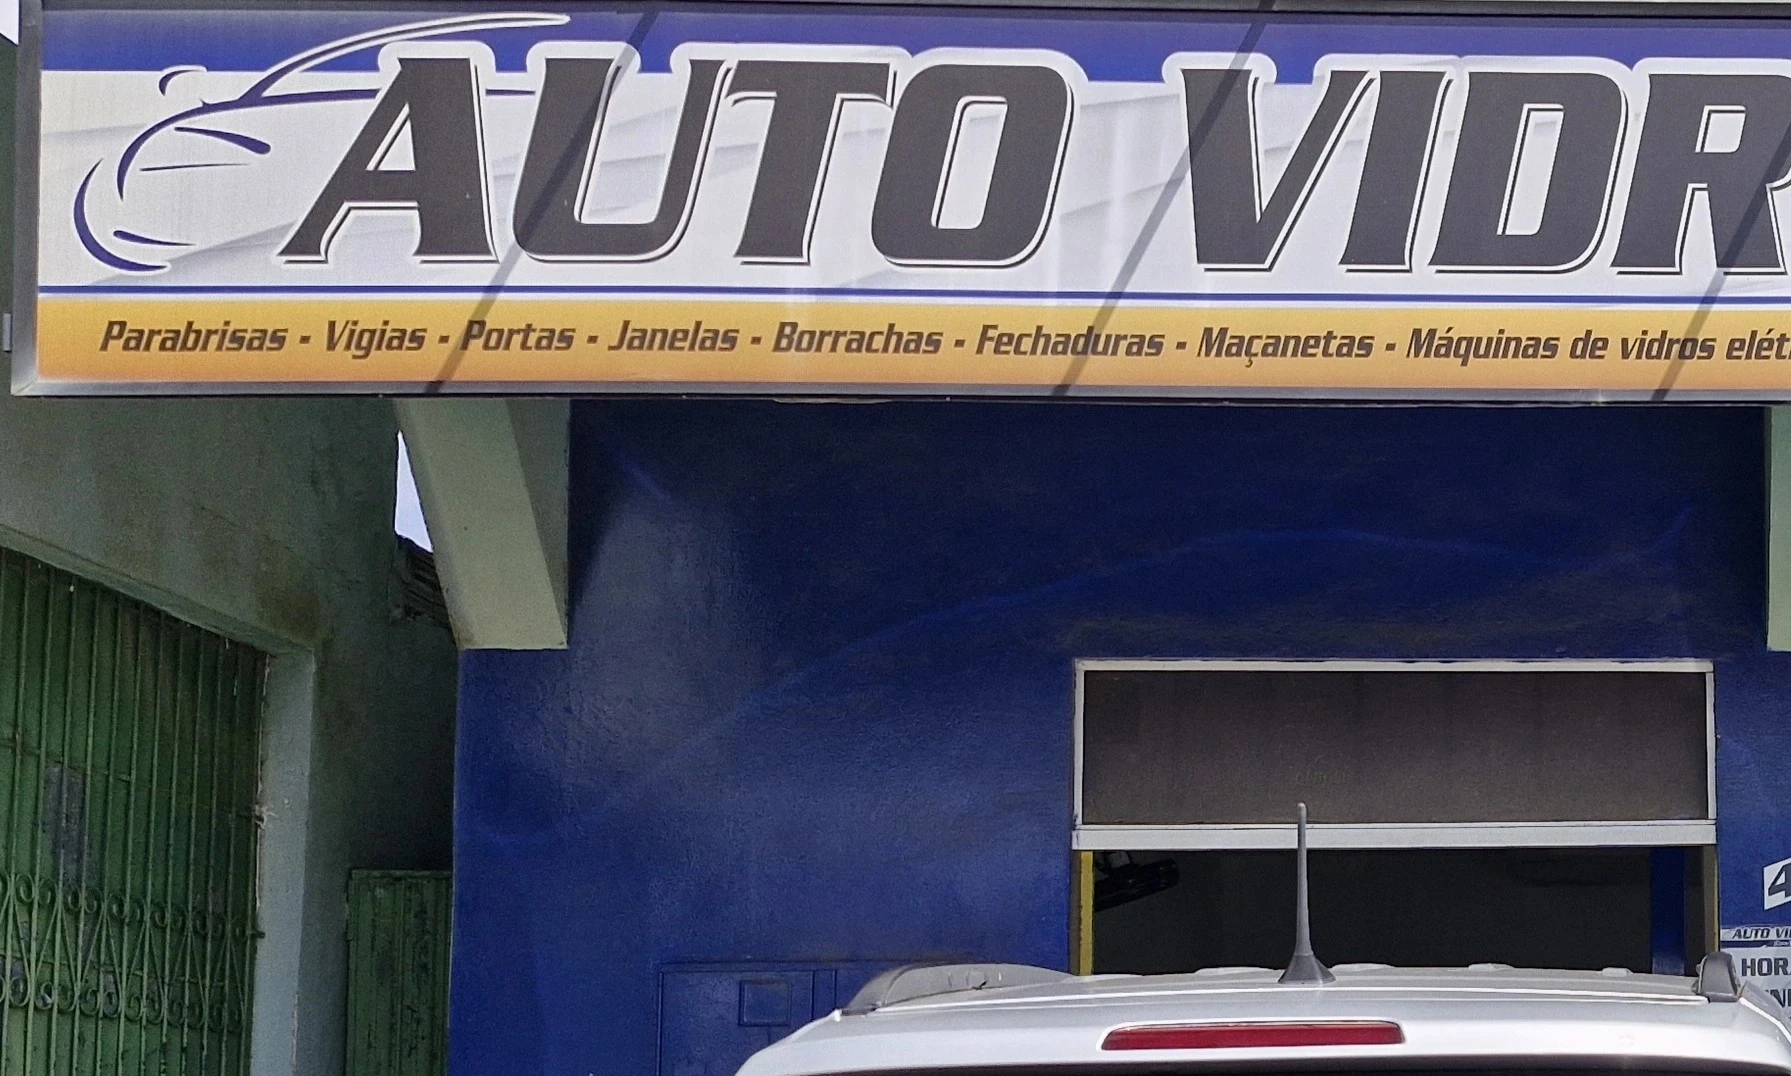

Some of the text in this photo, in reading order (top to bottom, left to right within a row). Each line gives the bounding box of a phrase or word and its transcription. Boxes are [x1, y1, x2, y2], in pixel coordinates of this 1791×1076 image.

[279, 56, 1076, 268] AUTO
[99, 320, 288, 353] Parabrisas
[325, 320, 427, 360] Vigias
[460, 320, 576, 352] Portas
[608, 320, 739, 352] Janelas
[773, 321, 943, 355] Borrachas
[976, 324, 1165, 357] Fechaduras
[1197, 327, 1375, 368] Maçanetas
[1406, 326, 1560, 367] Máquinas
[1569, 329, 1609, 360] de
[1621, 329, 1717, 361] vidros
[1732, 927, 1771, 940] AUTO
